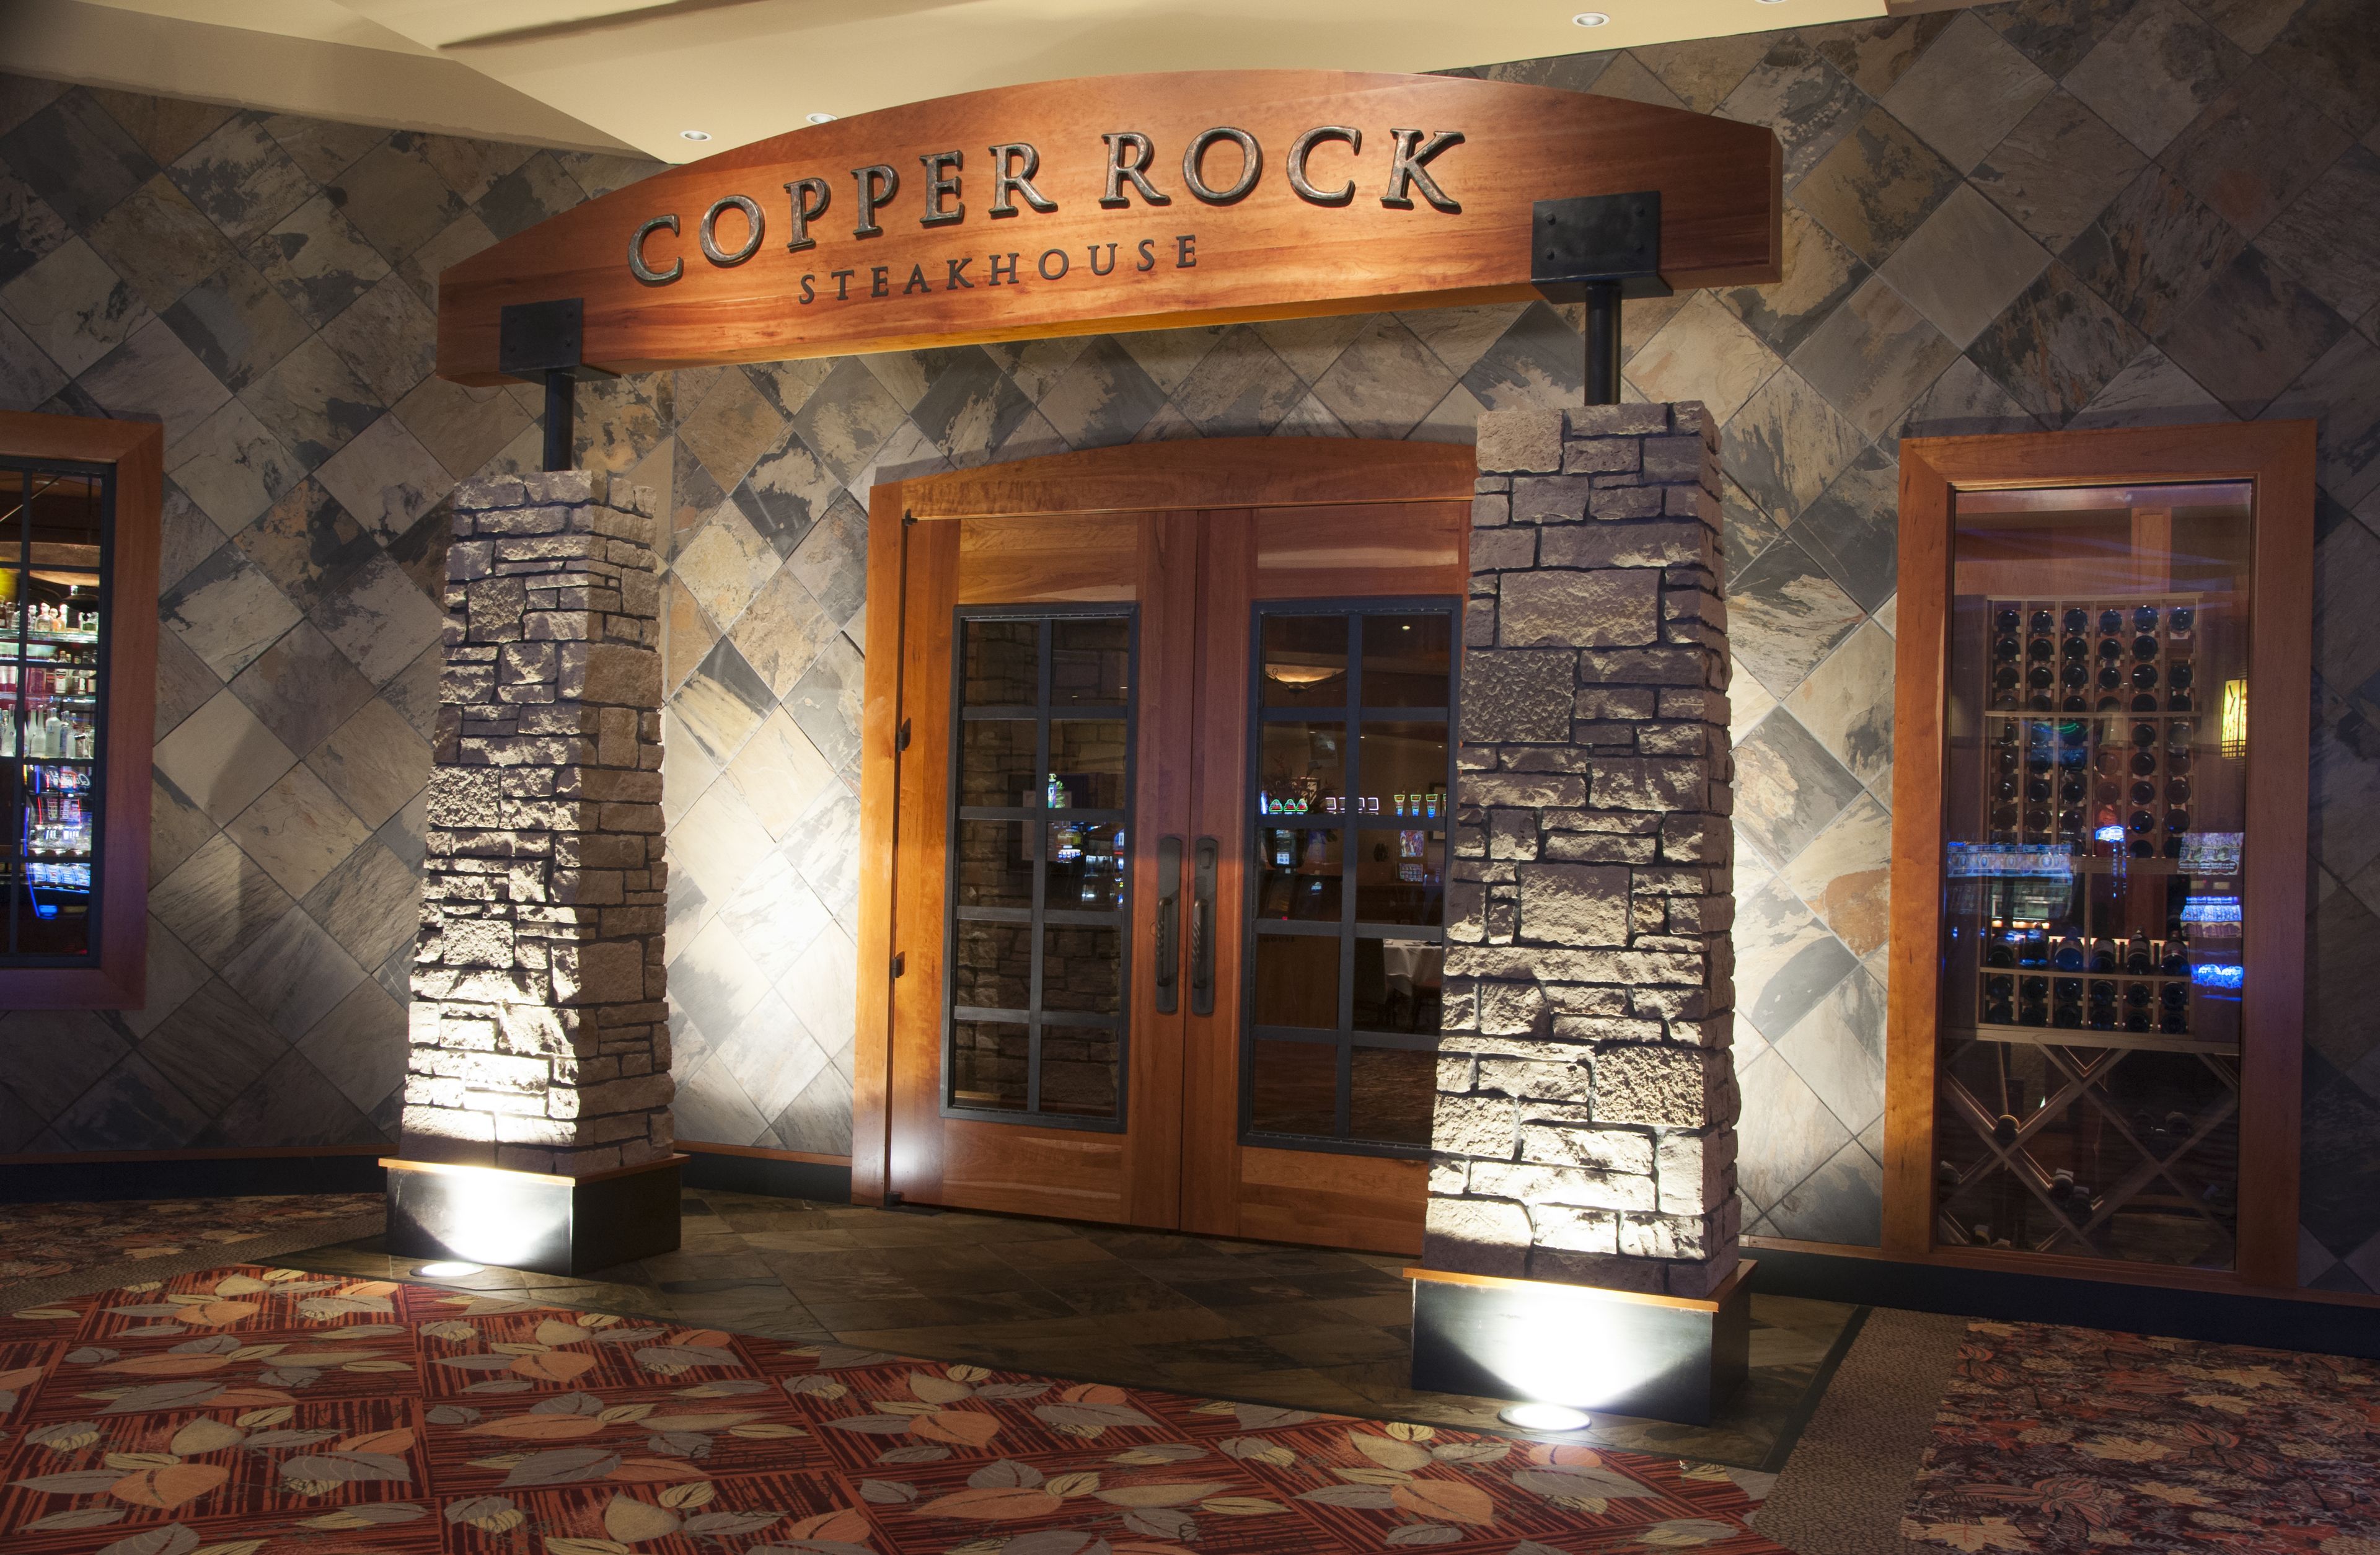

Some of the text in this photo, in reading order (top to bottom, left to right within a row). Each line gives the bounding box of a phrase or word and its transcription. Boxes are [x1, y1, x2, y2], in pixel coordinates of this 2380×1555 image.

[627, 126, 1466, 288] COPPER ROCK
[798, 234, 1197, 304] STEAKHOUSE
